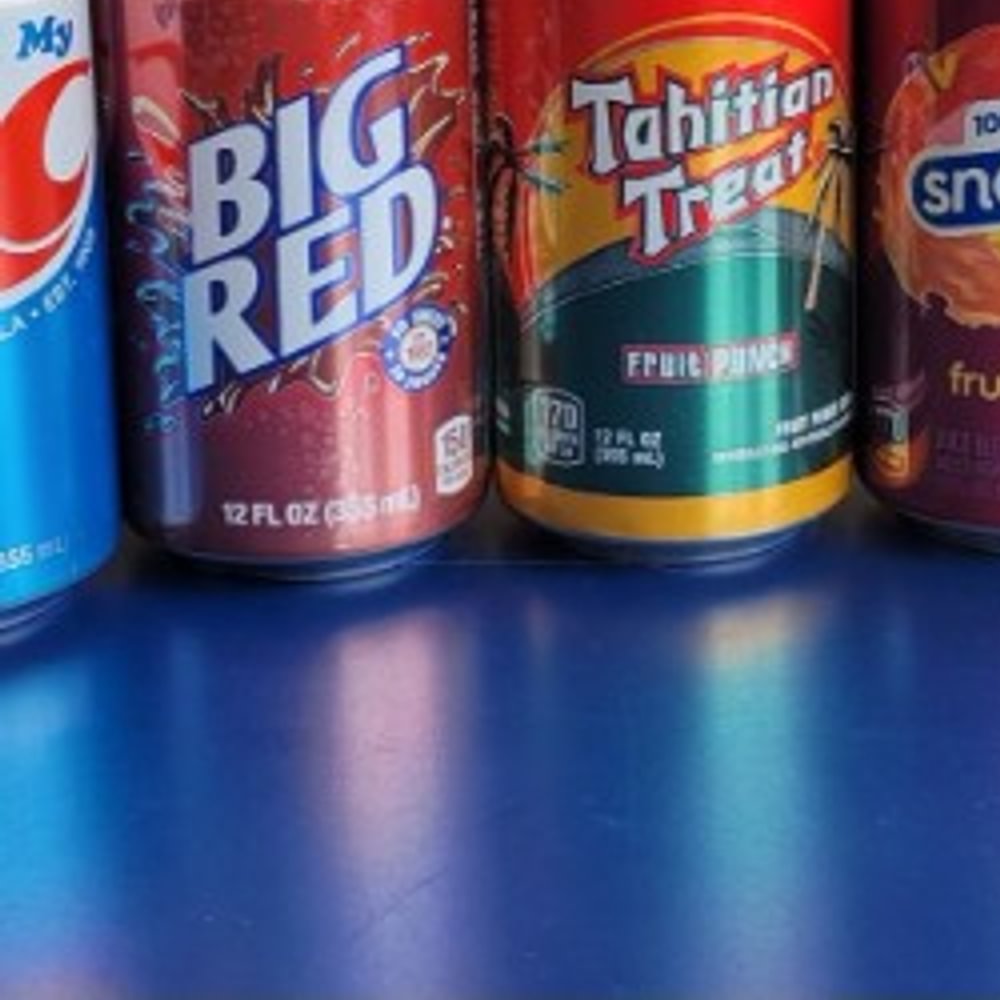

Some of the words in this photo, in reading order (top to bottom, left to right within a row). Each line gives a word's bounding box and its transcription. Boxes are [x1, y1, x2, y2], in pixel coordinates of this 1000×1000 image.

[16, 15, 74, 60] My
[188, 45, 404, 265] BIG
[571, 64, 836, 175] Tahitian
[622, 130, 808, 258] Treat
[183, 163, 440, 397] RED
[626, 351, 701, 379] FRUIT
[223, 502, 249, 527] 12
[252, 502, 282, 527] FL
[285, 502, 320, 527] OZ
